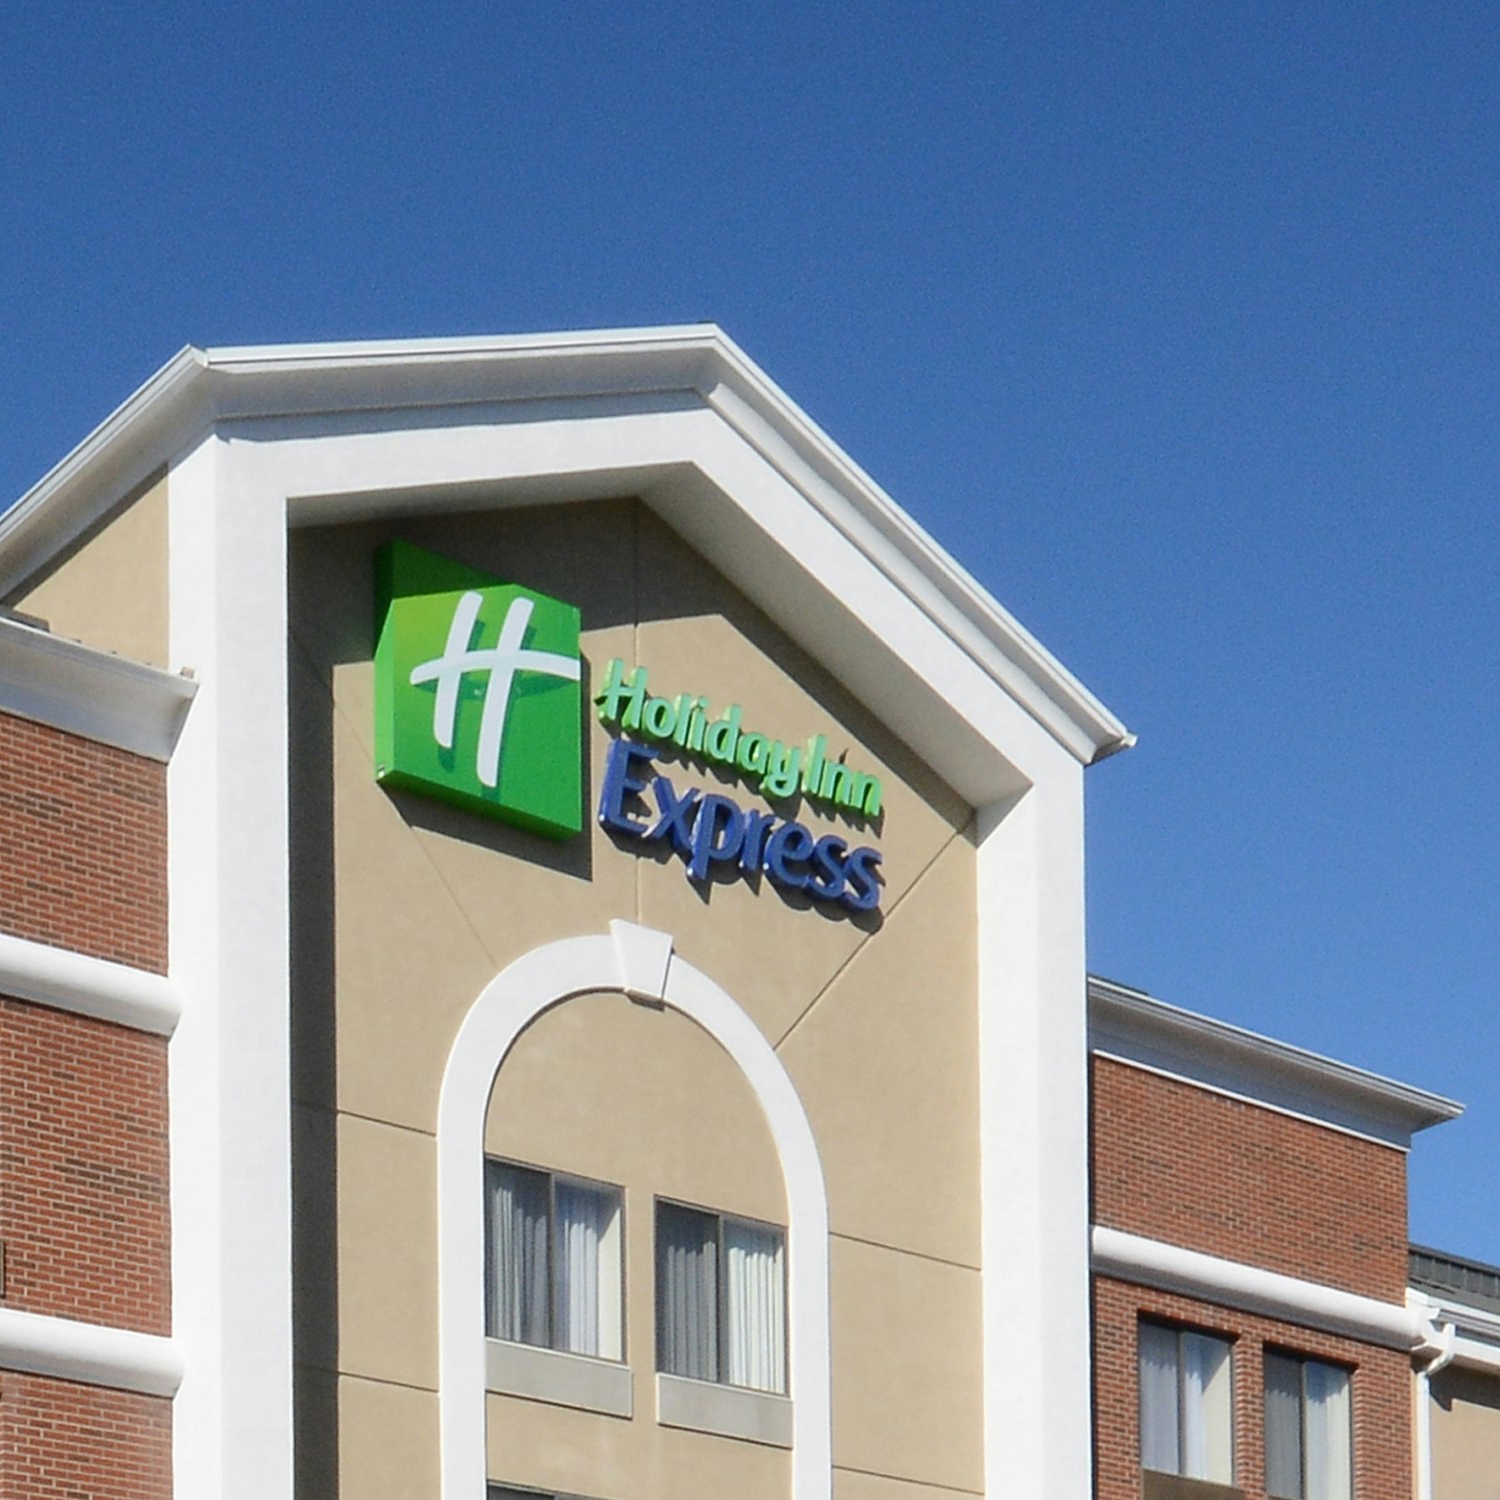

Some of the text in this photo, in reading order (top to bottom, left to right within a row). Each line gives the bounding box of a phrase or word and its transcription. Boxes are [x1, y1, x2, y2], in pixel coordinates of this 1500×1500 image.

[598, 657, 883, 817] Holiday Inn
[598, 737, 884, 911] Express
